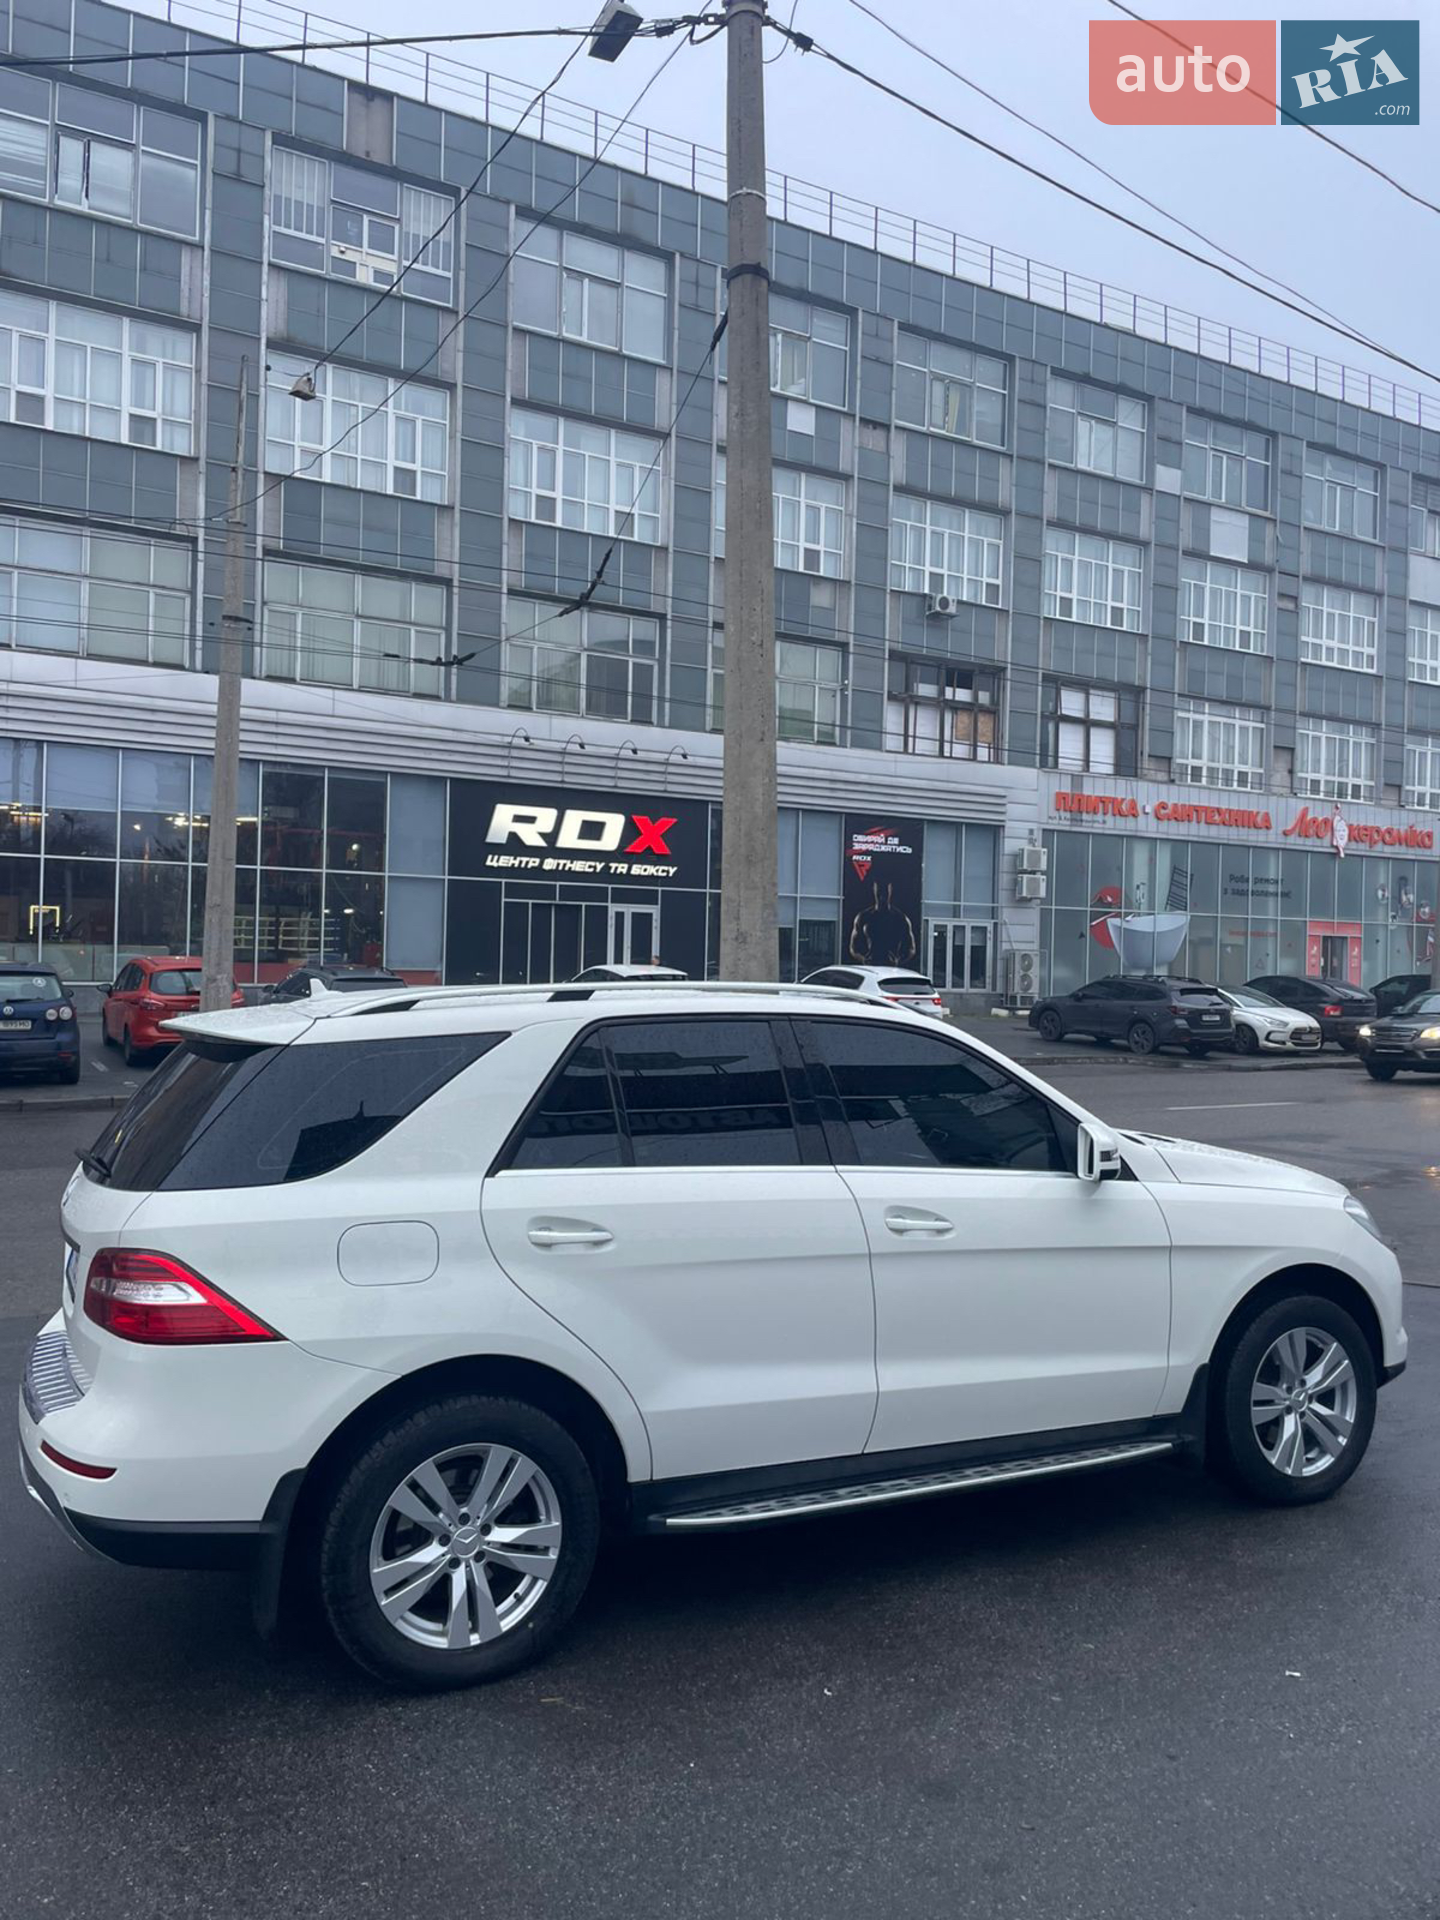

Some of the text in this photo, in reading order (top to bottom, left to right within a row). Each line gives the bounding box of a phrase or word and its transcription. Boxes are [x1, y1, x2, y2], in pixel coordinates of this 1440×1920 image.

[484, 803, 679, 855] RDX
[1055, 791, 1272, 830] ПЛИТКА САНТЕХНІКА
[485, 854, 678, 877] ЦЕНТР ФІТНЕСУ ТА БОКСУ
